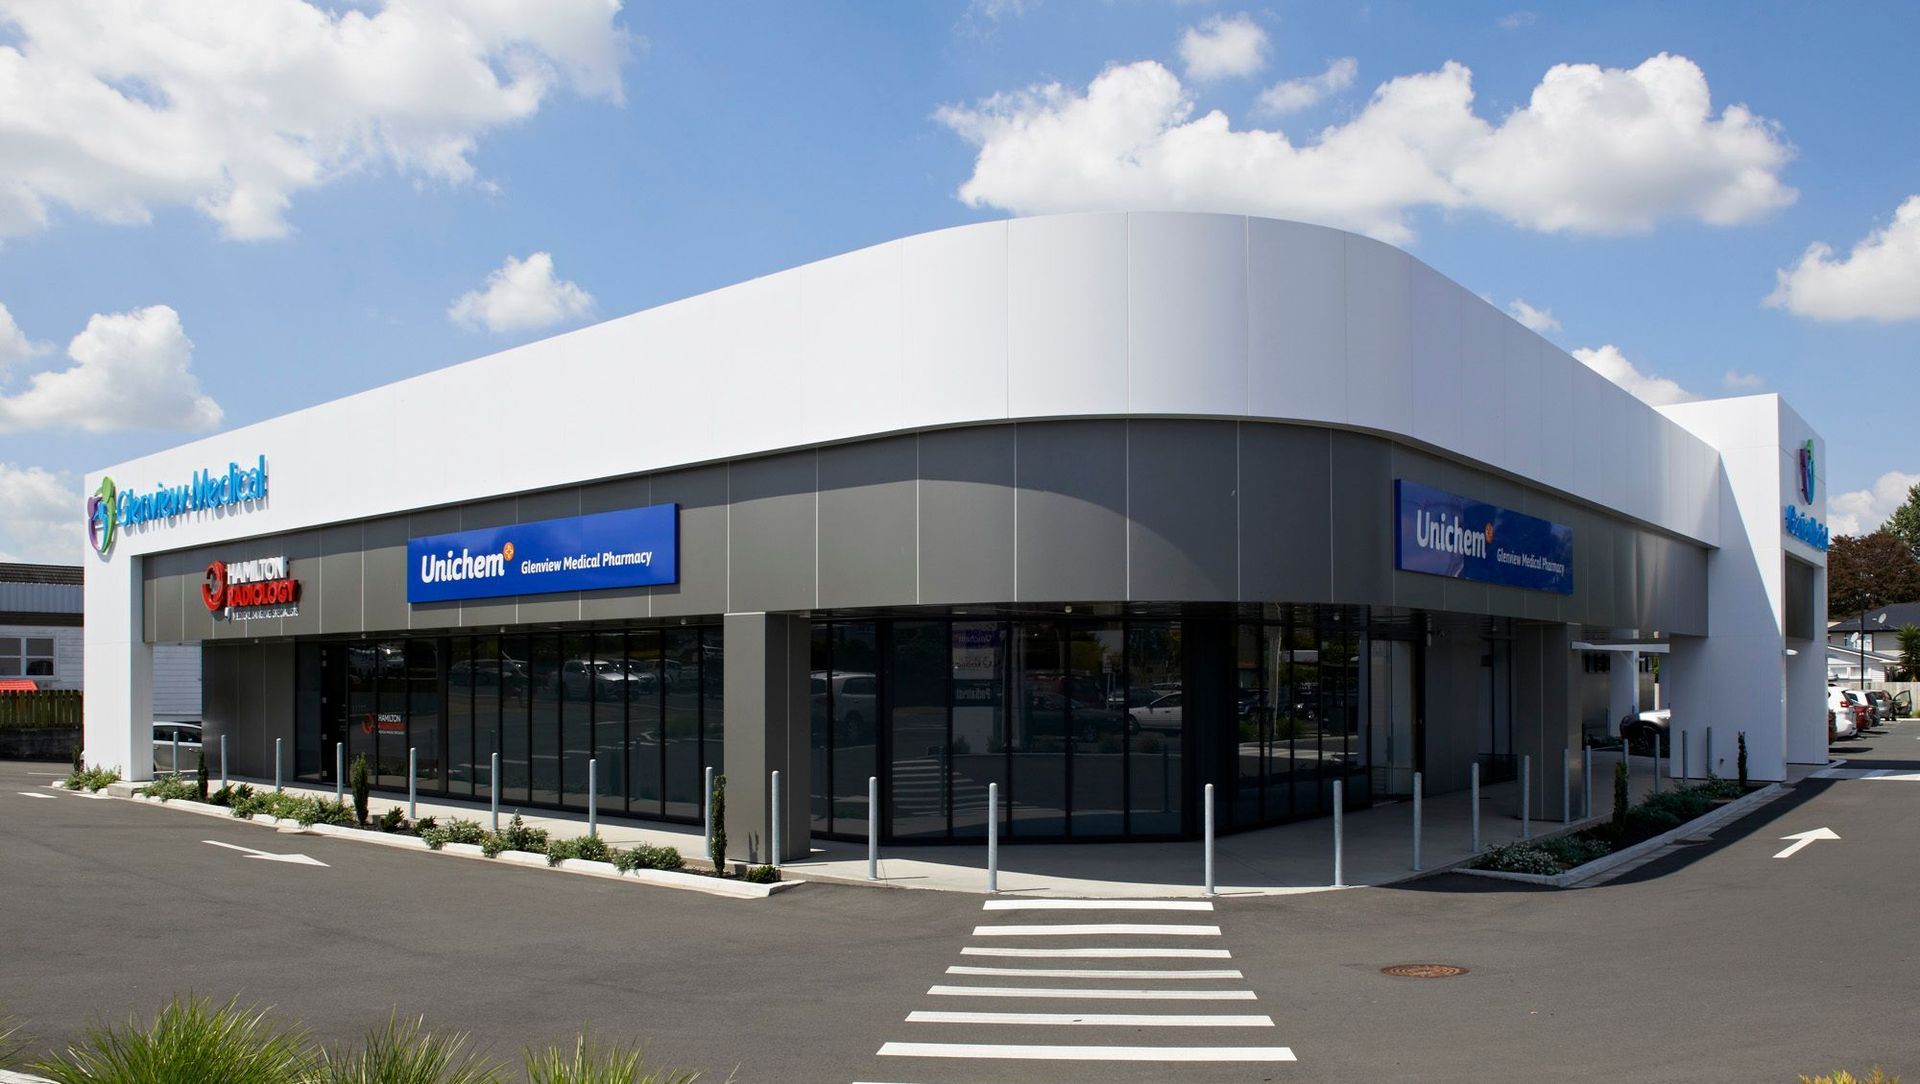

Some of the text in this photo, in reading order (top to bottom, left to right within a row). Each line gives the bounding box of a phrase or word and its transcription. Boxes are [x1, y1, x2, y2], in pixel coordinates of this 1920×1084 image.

[116, 455, 266, 526] Glenview Medical
[1416, 509, 1487, 560] Unichem
[227, 556, 285, 585] HAMILTON
[421, 548, 505, 583] Unichem
[521, 551, 653, 575] Glenview Medical Pharmacy
[1497, 548, 1565, 577] Glenview Medical Pharmacy
[227, 579, 295, 607] RADIOLOGY
